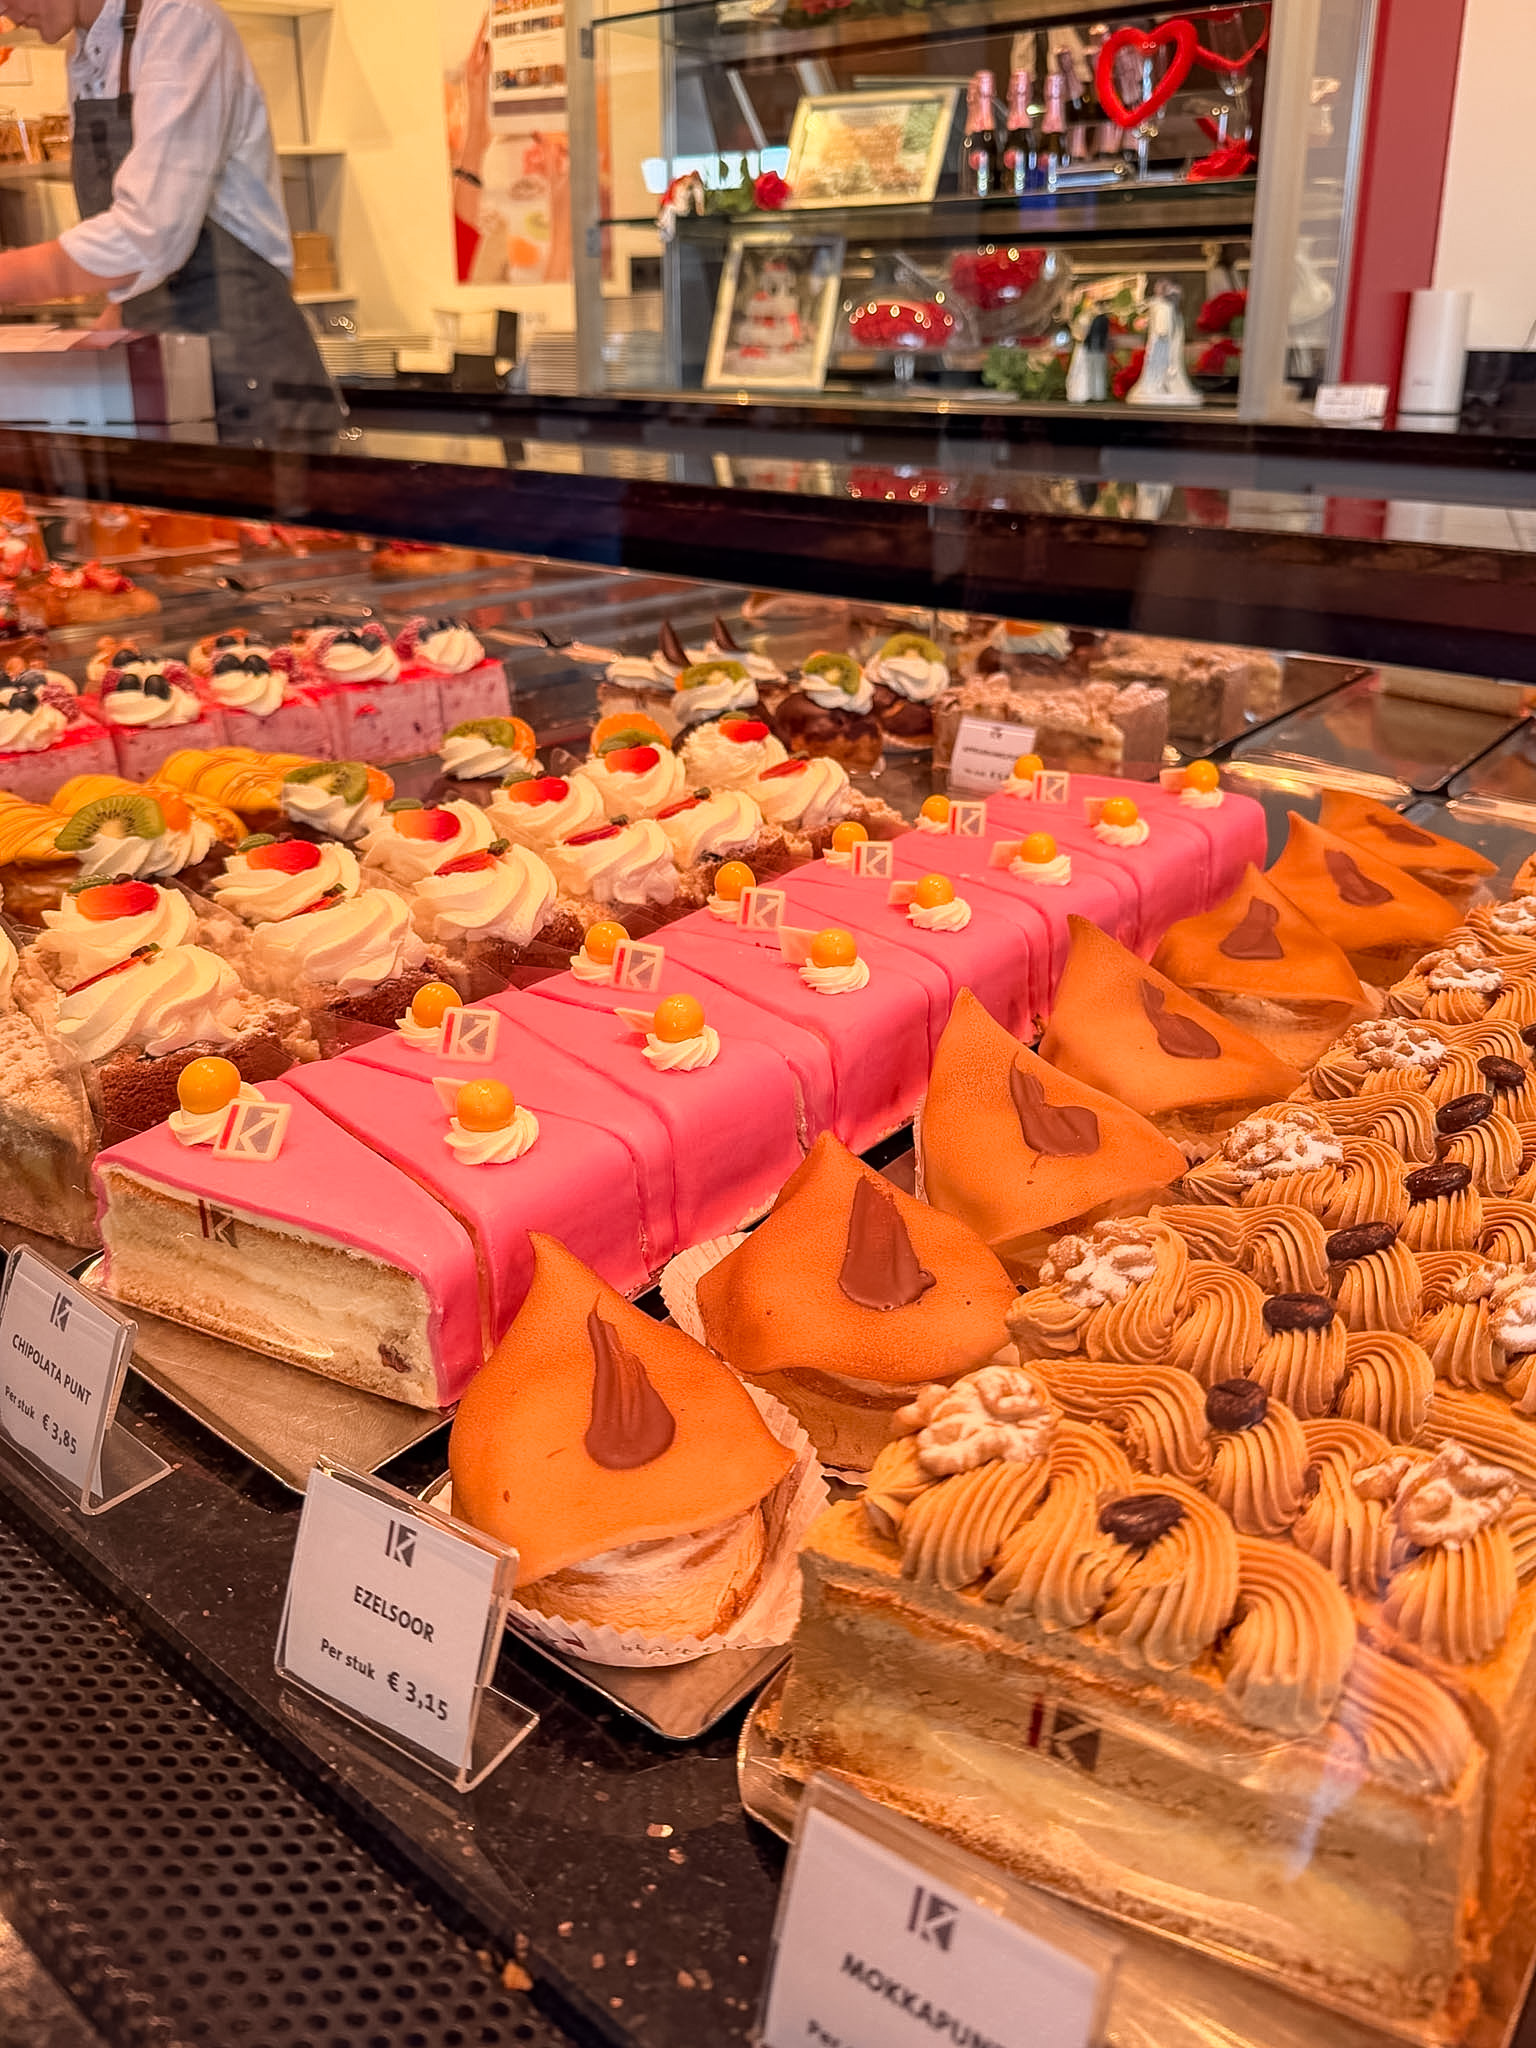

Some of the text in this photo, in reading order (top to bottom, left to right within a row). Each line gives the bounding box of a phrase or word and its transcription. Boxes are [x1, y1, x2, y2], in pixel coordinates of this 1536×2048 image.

[12, 1334, 92, 1405] CHIPOLATA PUNT
[5, 1385, 77, 1455] Per stuk € 3,85
[353, 1584, 435, 1643] EZELSOOR
[320, 1638, 449, 1721] Per stuk € 3,15
[841, 1952, 1008, 2048] MOKKAPUN
